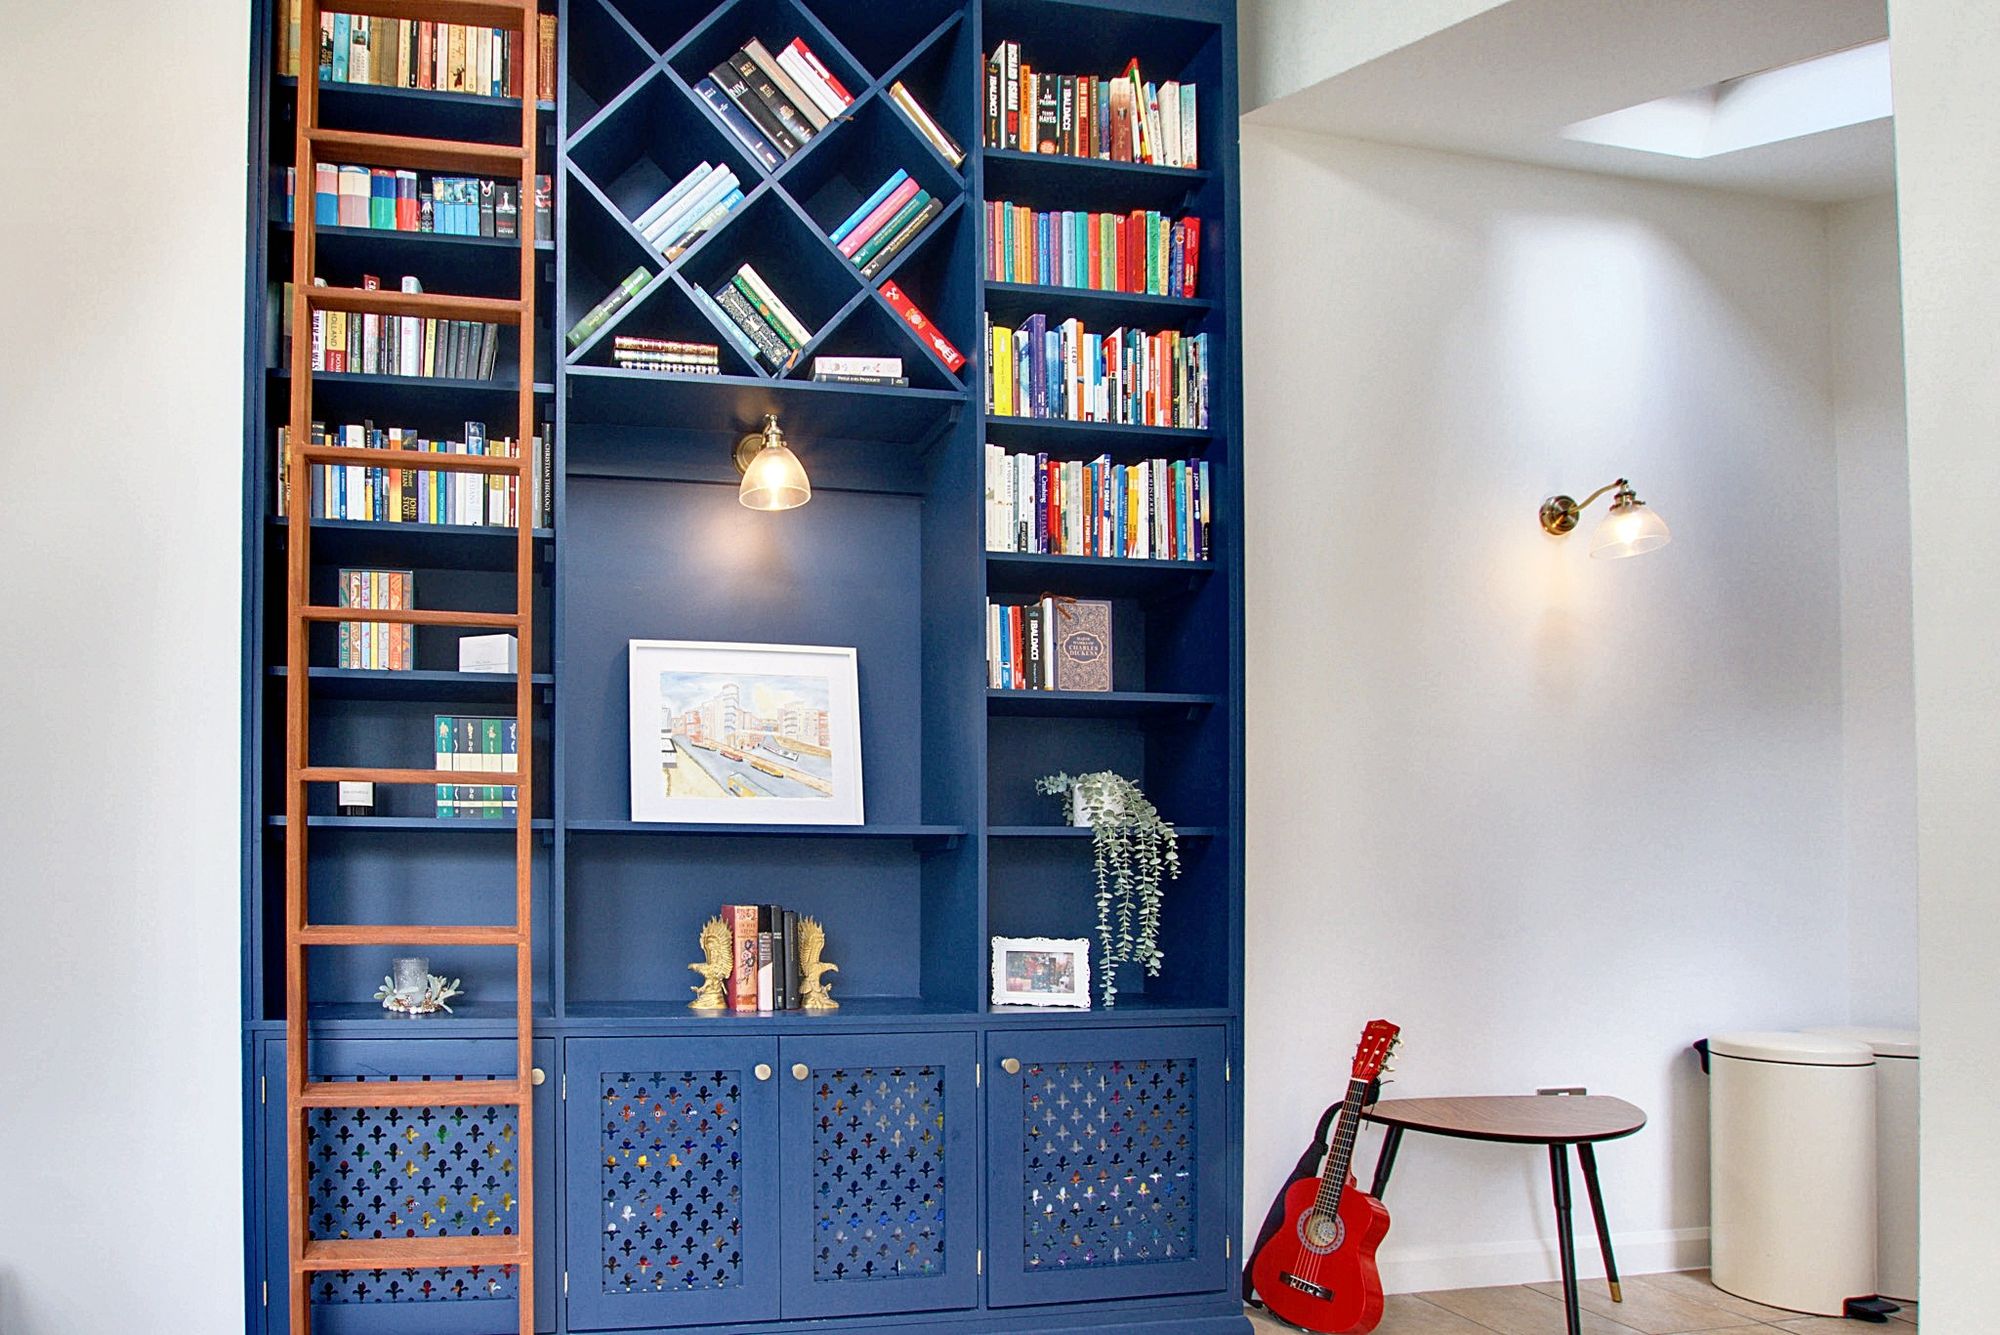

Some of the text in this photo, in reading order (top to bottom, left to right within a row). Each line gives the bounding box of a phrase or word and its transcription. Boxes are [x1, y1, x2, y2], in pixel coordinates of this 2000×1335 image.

[1008, 44, 1017, 79] RICHARD
[729, 81, 746, 97] NIV
[989, 80, 997, 116] BALDACCI
[1008, 81, 1017, 110] OSMAN
[1063, 92, 1071, 131] BALDACCI
